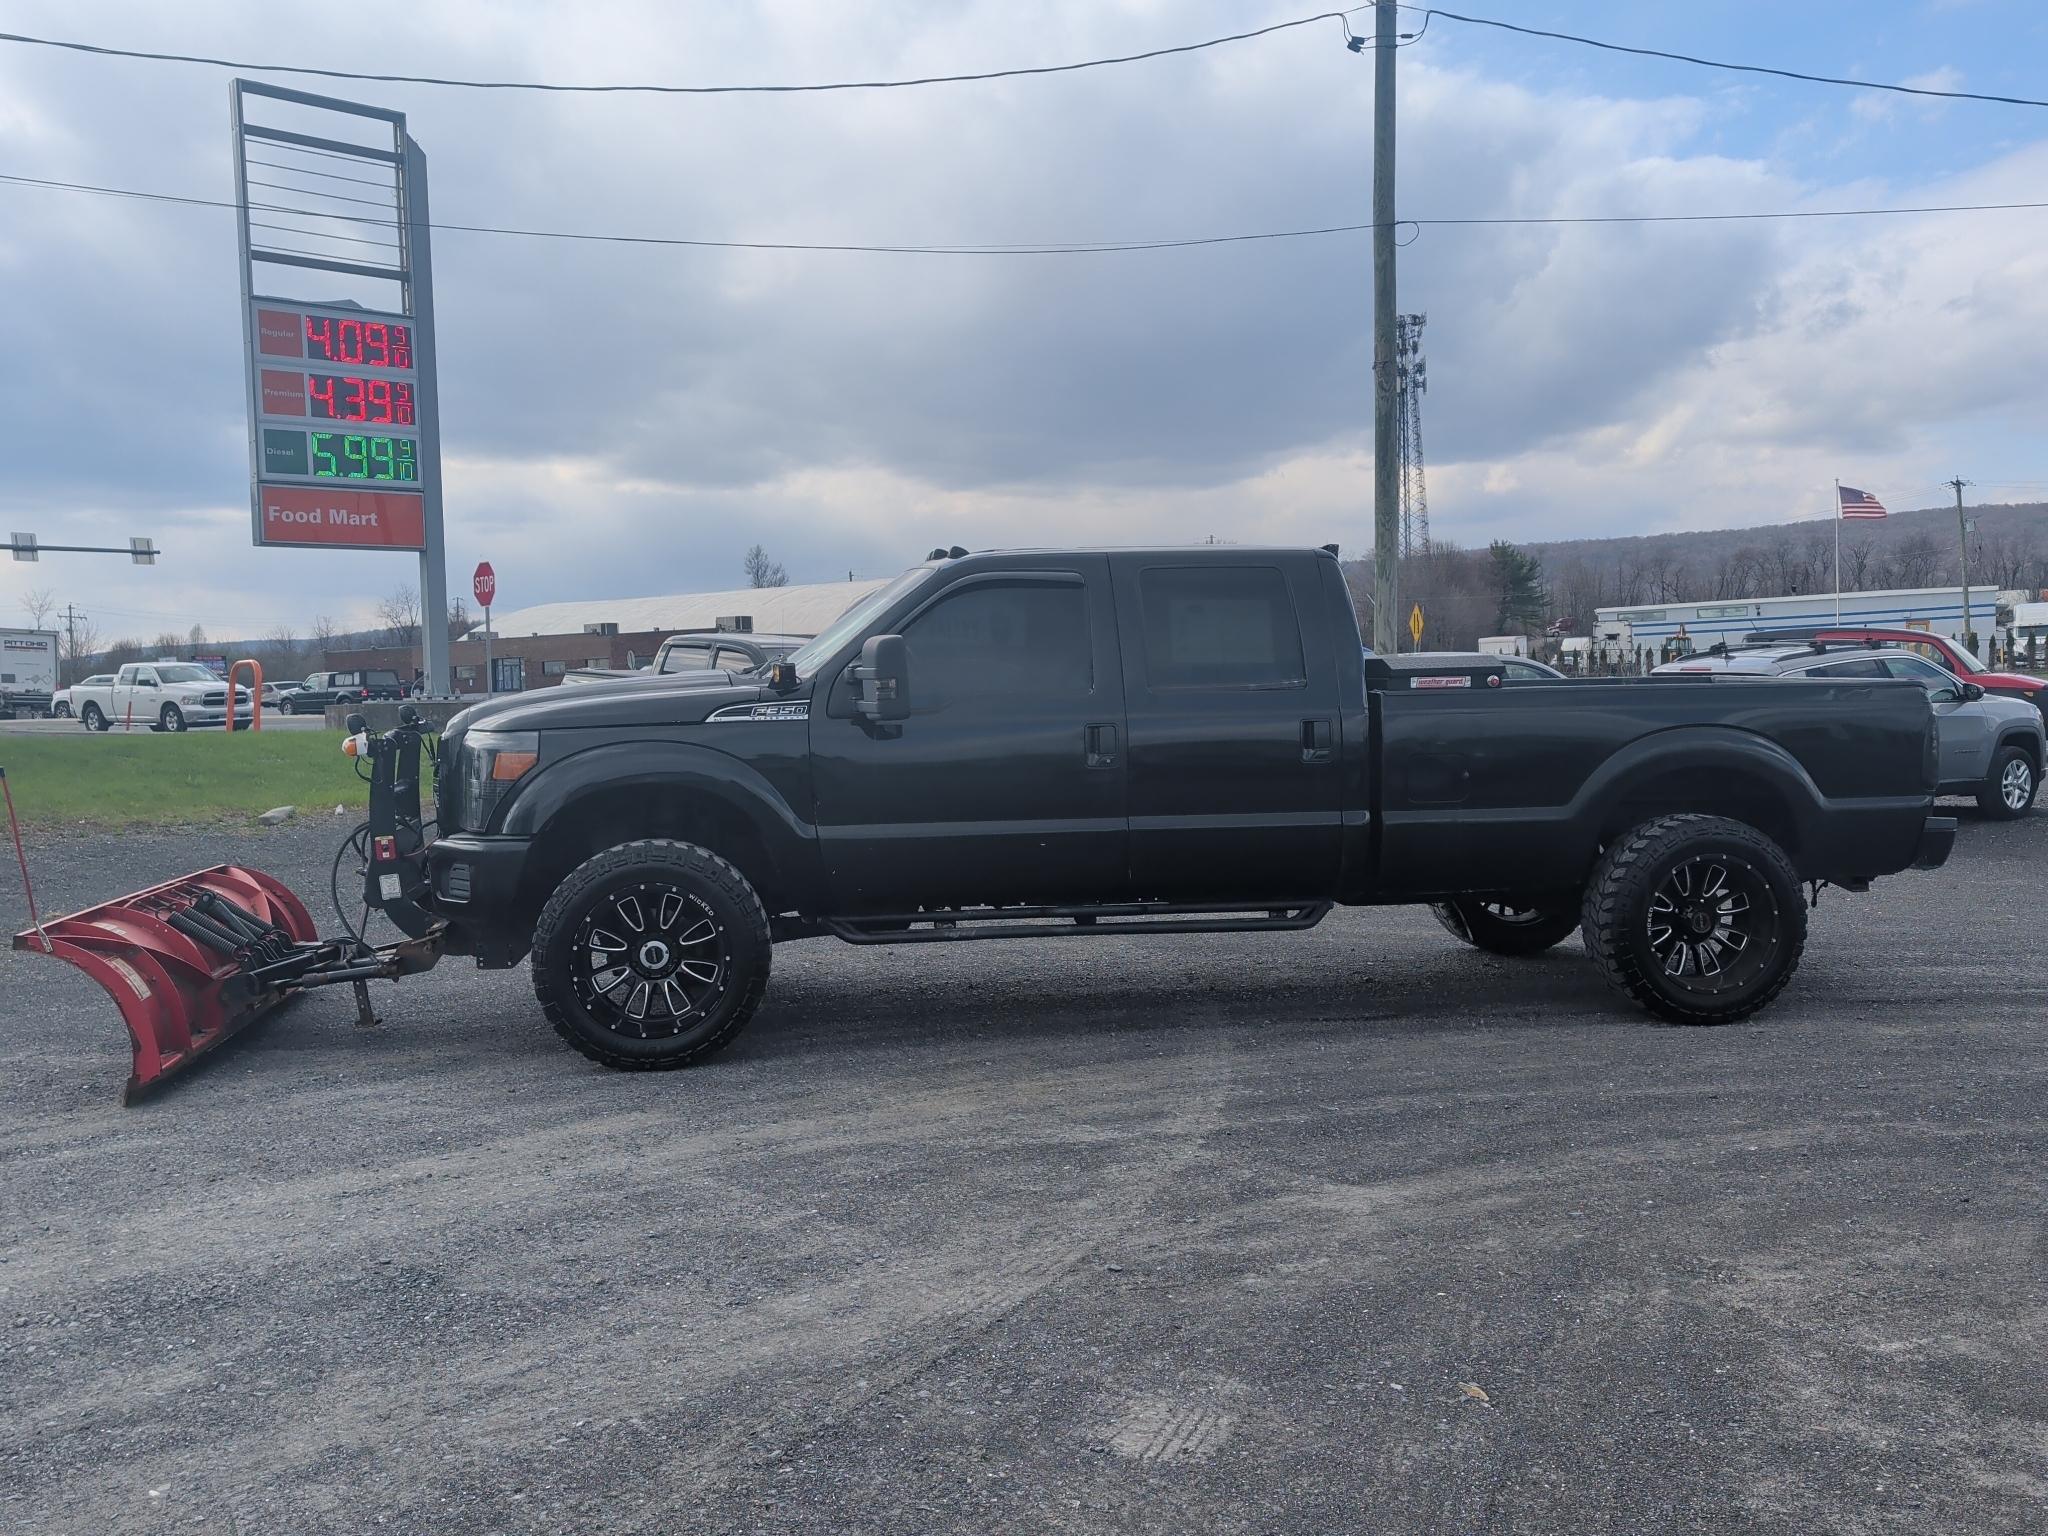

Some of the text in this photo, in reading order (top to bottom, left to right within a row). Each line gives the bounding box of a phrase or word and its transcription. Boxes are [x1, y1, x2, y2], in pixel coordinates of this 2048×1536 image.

[306, 317, 388, 367] 4.09
[309, 377, 393, 424] 4.39
[266, 447, 294, 456] Diesel
[312, 432, 394, 481] 5.99
[268, 506, 379, 527] Food Mart
[475, 576, 494, 593] STOP
